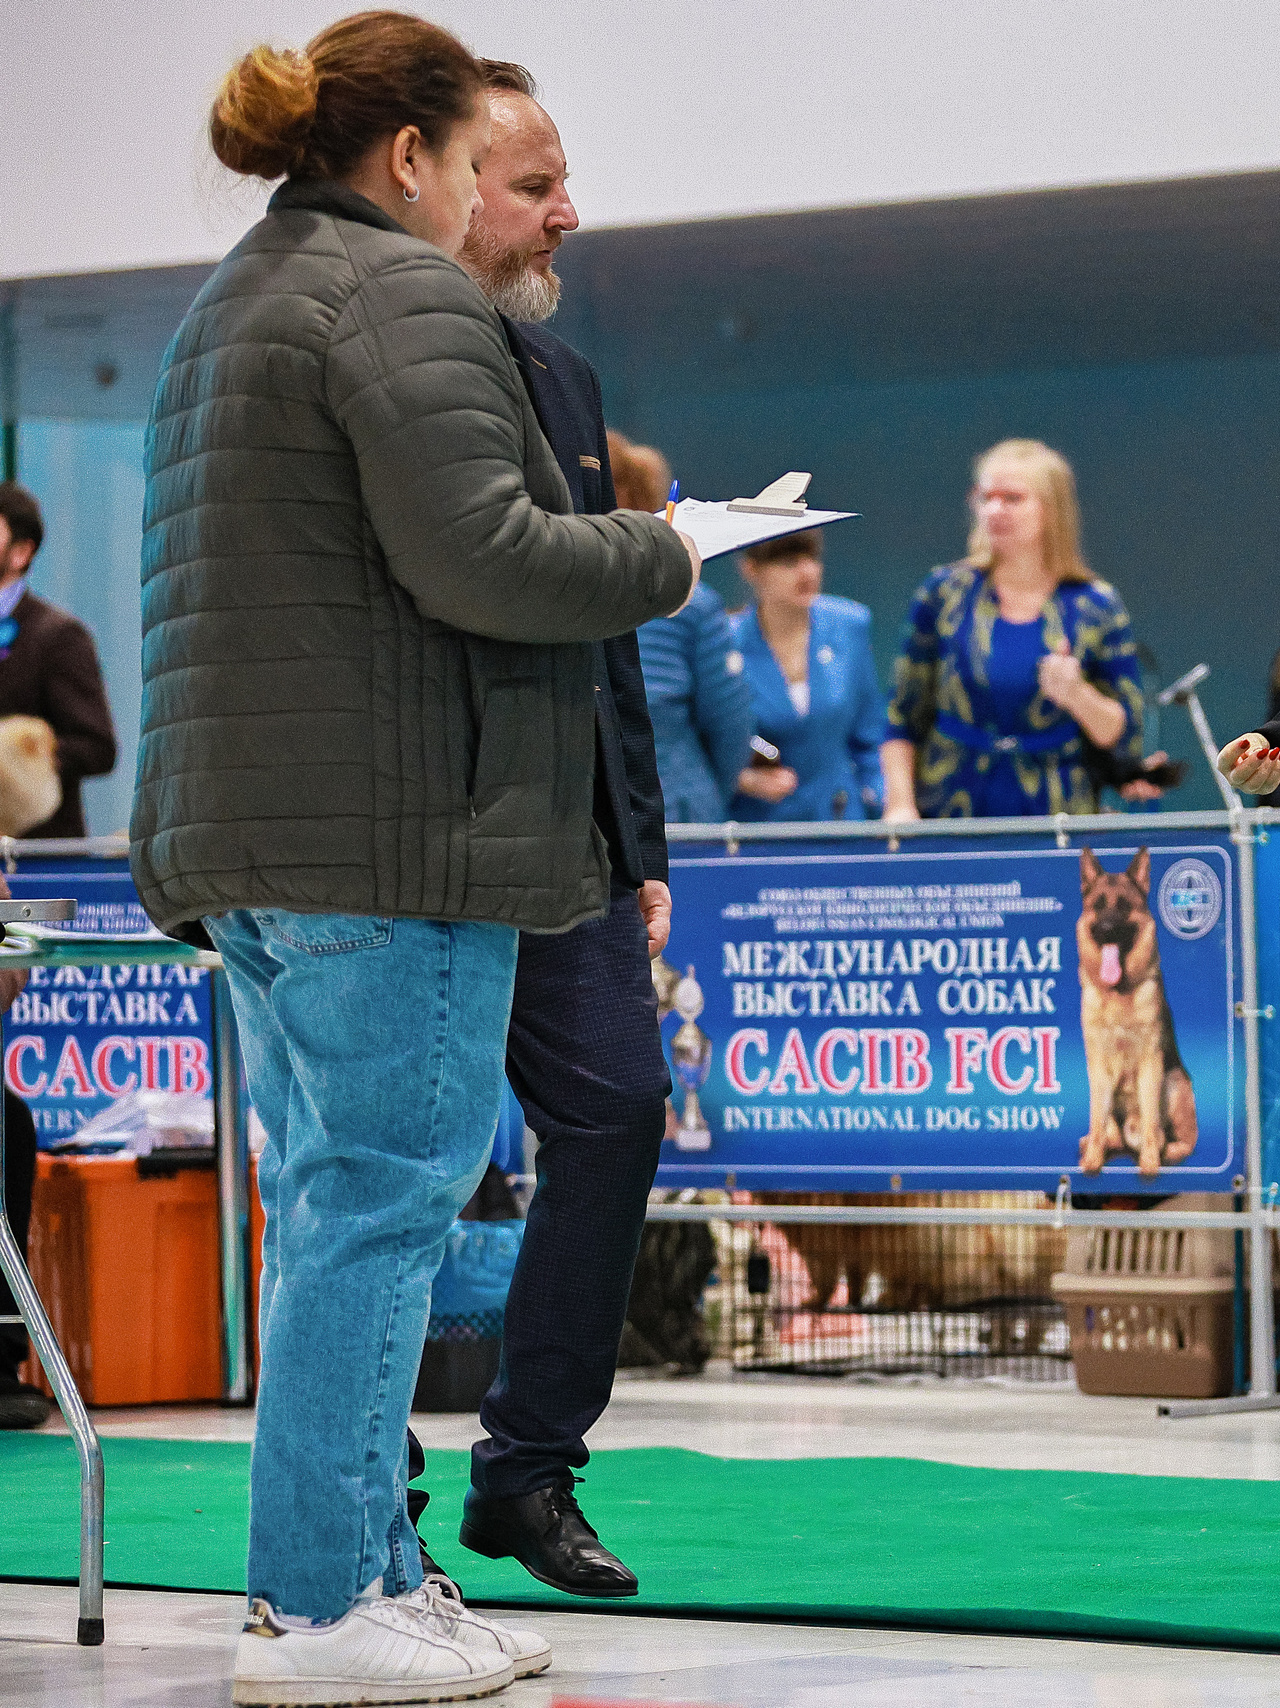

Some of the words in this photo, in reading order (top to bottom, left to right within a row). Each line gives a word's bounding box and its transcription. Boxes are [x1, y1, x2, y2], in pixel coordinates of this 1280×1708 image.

[723, 936, 1062, 978] МЕЖДУНАРОДНАЯ
[30, 963, 209, 991] ЕЖДУНАР
[11, 991, 199, 1025] ВЫСТАВКА
[733, 980, 922, 1017] ВЫСТАВКА
[937, 978, 1056, 1016] СОБАК
[4, 1034, 212, 1099] CACIB
[725, 1027, 933, 1096] CACIB
[944, 1026, 1061, 1095] FCI
[723, 1106, 920, 1132] INTERNATIONAL
[926, 1105, 981, 1131] DOG
[986, 1105, 1065, 1131] SHOW
